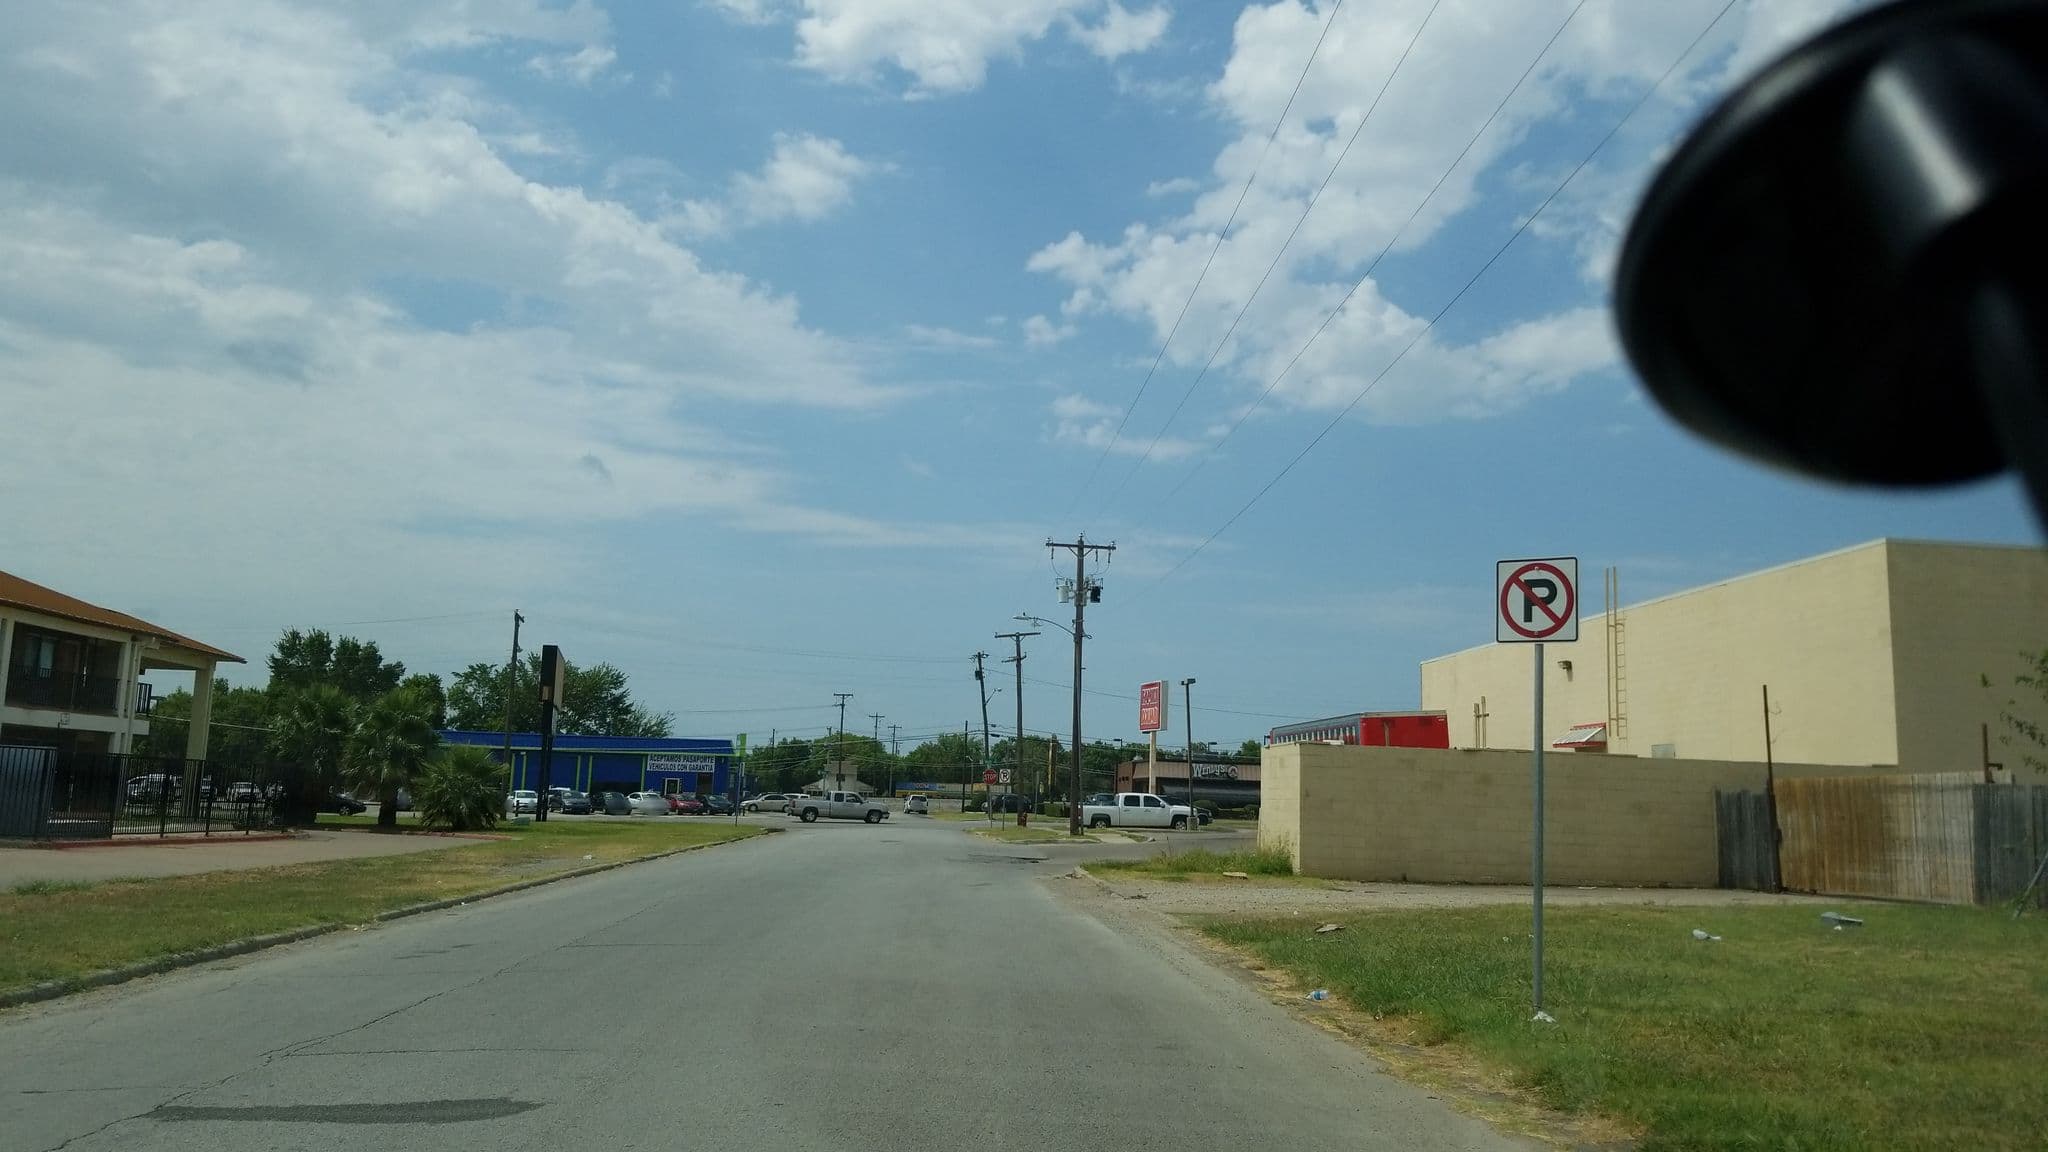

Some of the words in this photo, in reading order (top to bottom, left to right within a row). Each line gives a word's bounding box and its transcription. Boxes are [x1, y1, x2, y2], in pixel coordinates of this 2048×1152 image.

[1524, 579, 1558, 623] P
[649, 762, 677, 770] VEHICULOS
[677, 763, 688, 771] CON
